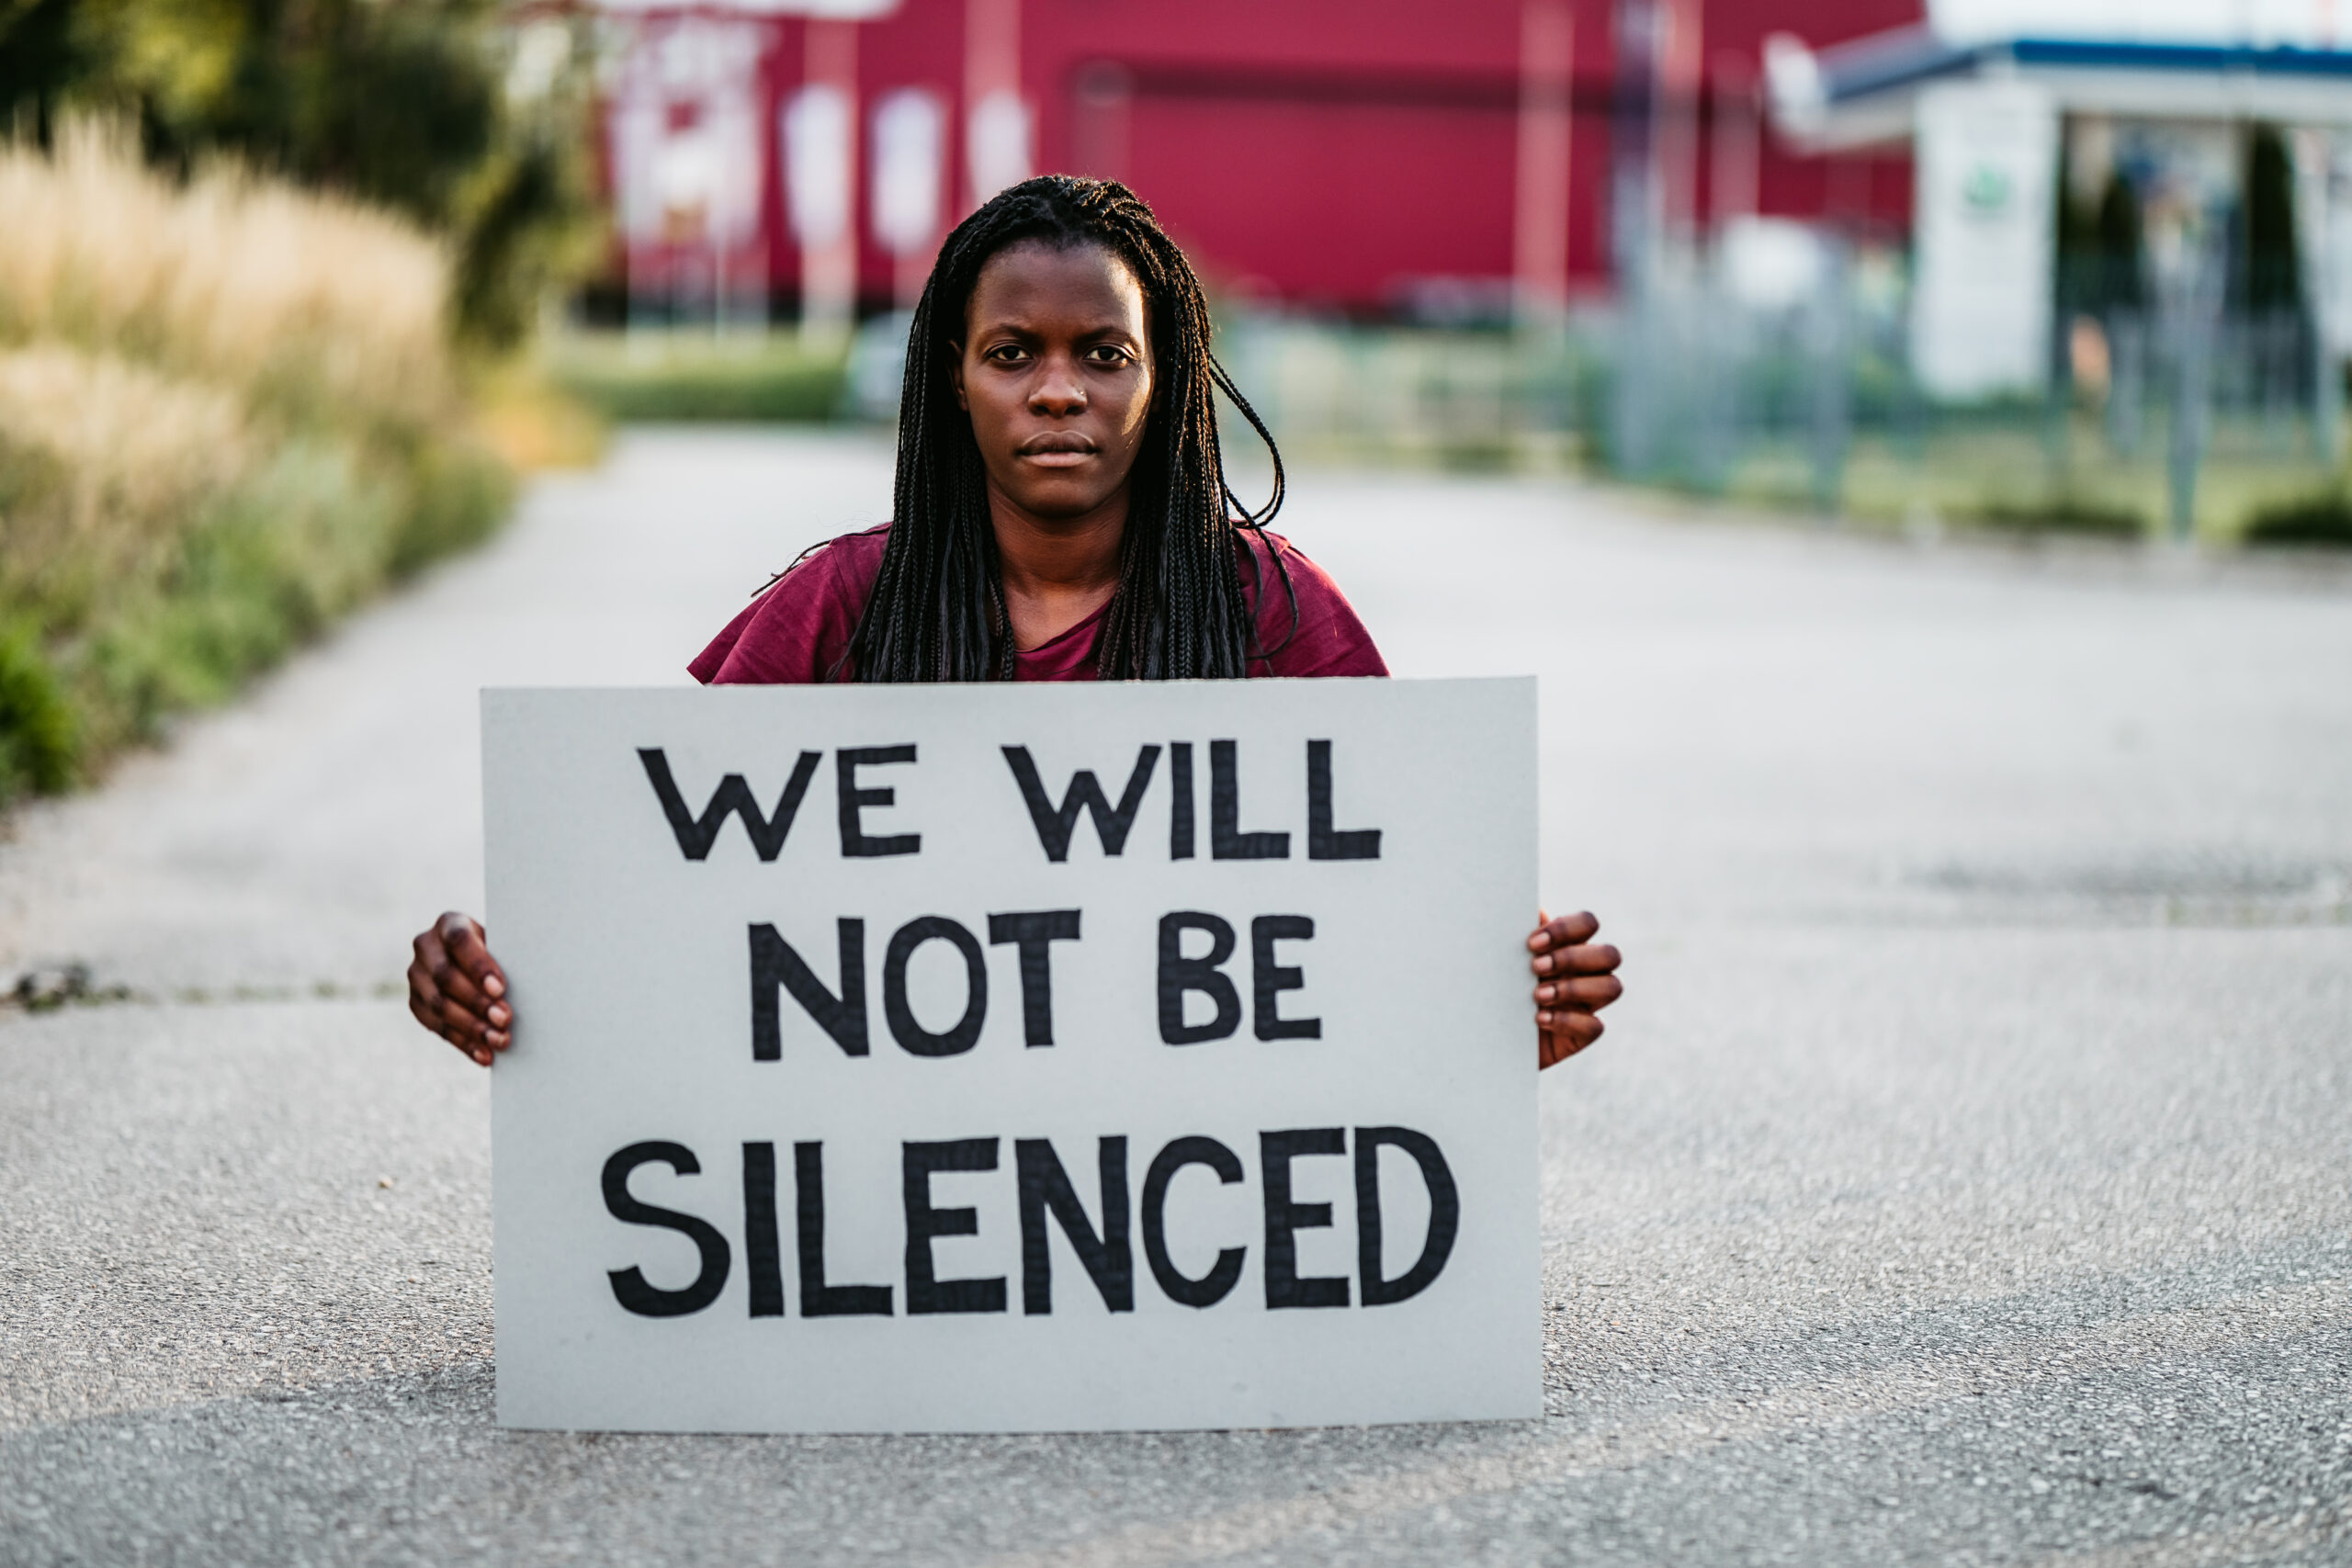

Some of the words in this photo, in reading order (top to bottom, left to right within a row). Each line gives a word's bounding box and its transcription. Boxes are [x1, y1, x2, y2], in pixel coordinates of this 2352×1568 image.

[636, 743, 922, 863] WE
[1001, 739, 1383, 863] WILL
[748, 908, 1081, 1062] NOT
[1157, 910, 1322, 1046] BE
[600, 1125, 1460, 1319] SILENCED
